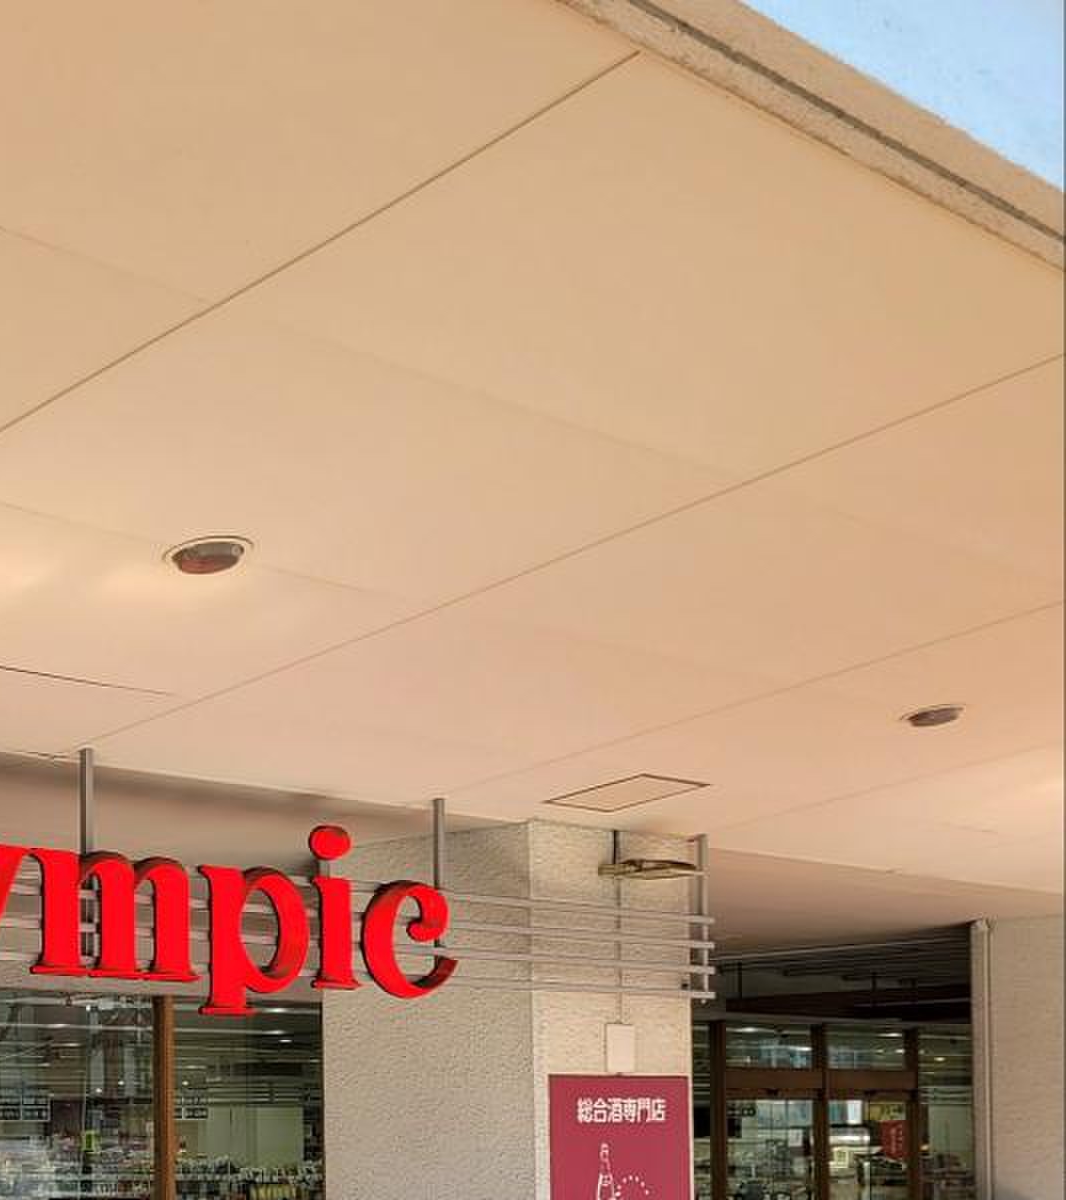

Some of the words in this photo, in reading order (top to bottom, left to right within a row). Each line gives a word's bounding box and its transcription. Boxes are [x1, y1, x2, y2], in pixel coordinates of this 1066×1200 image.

[576, 1097, 667, 1124] 総合酒専門店
